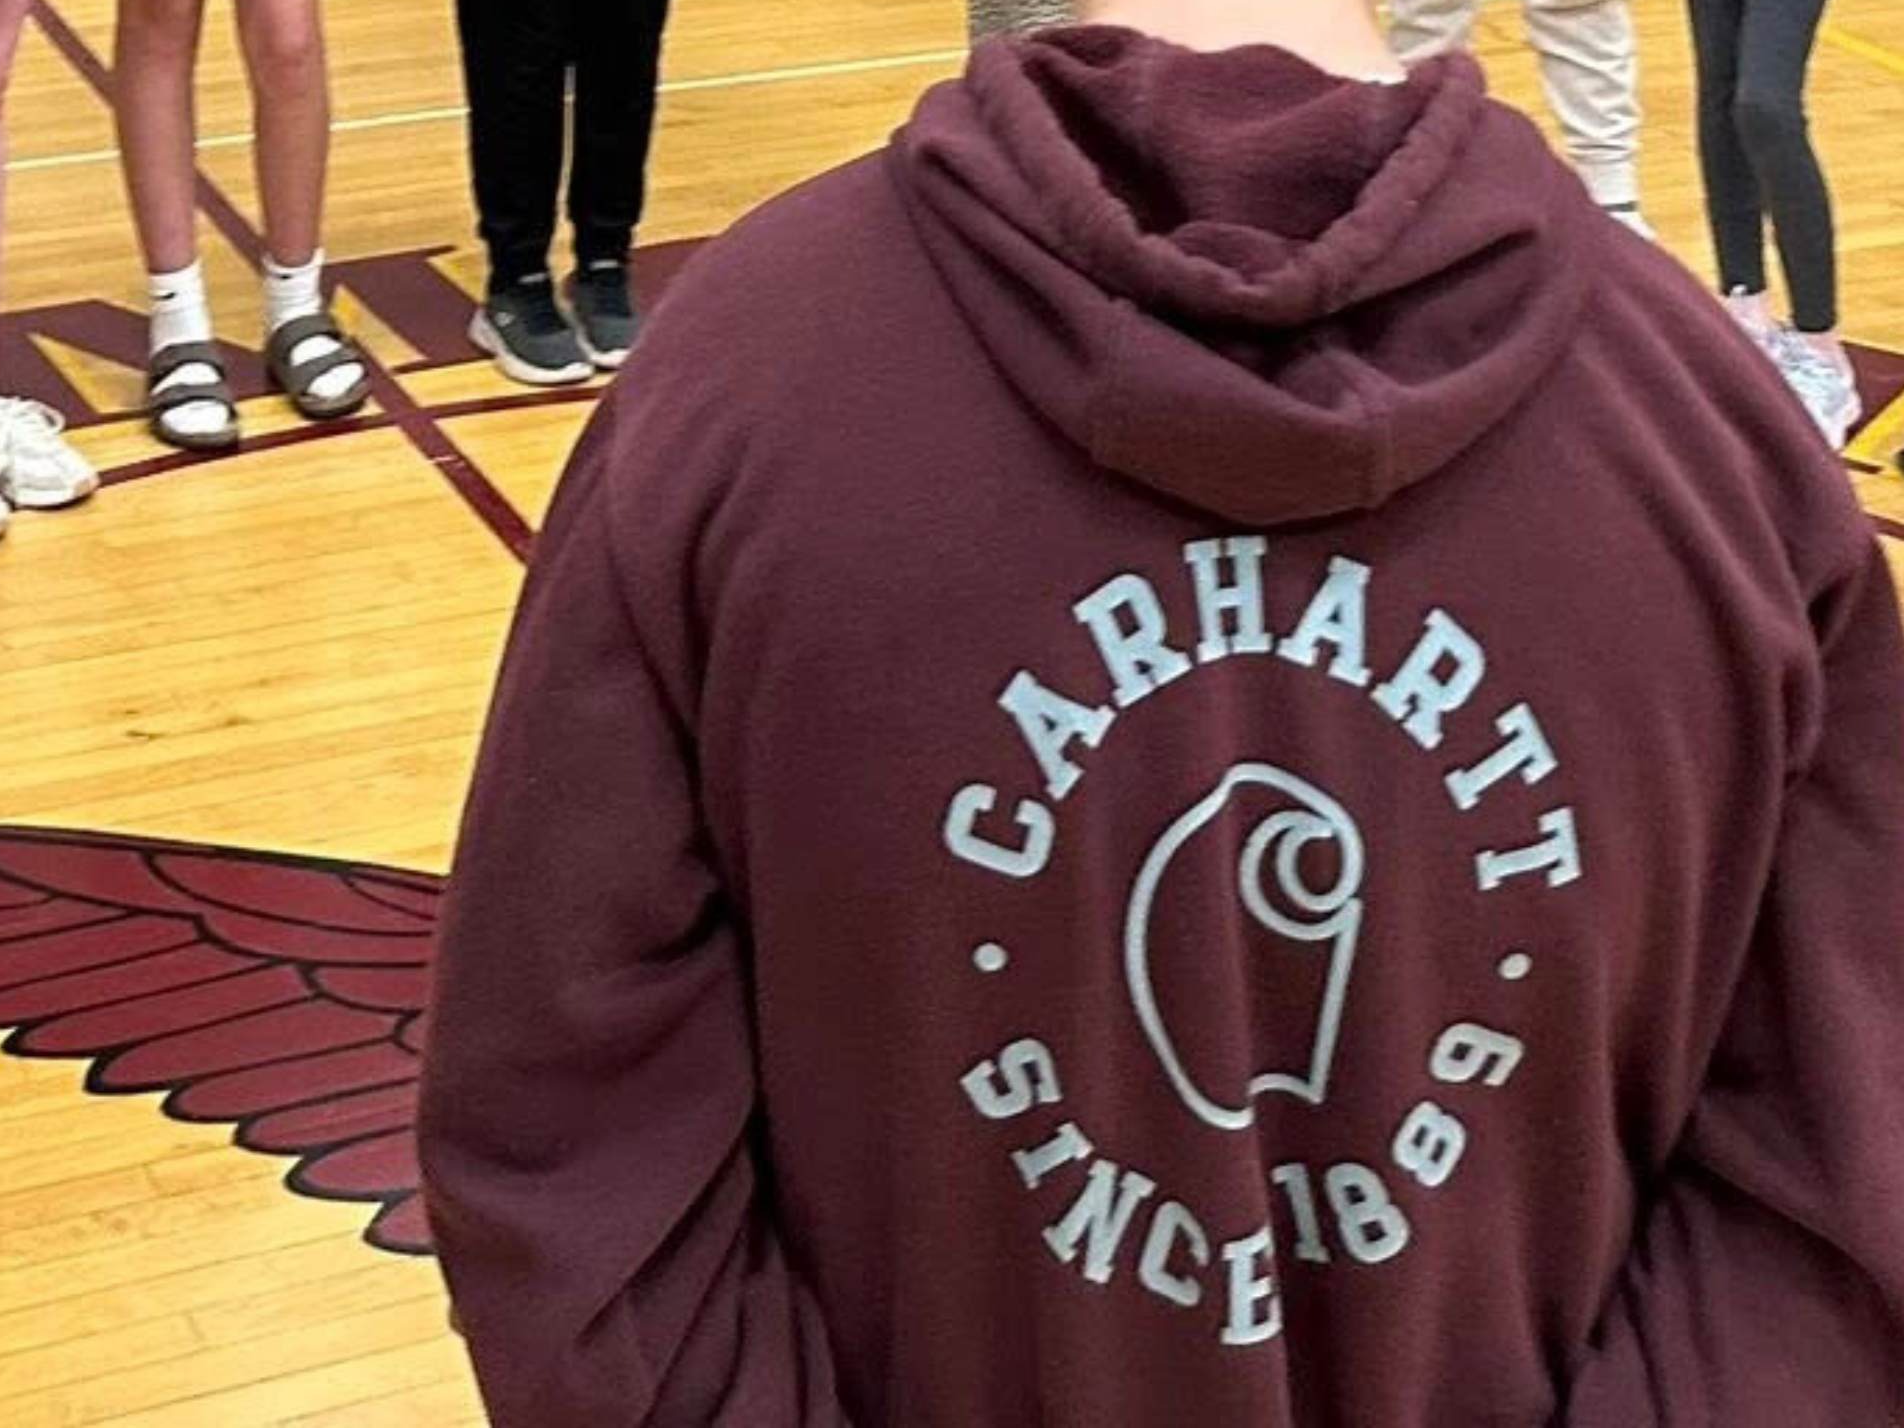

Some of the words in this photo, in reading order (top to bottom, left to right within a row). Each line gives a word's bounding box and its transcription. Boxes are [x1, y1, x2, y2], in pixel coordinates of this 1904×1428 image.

[944, 535, 1582, 891] CARHARTT
[960, 1037, 1284, 1347] SINCE
[1271, 1021, 1525, 1265] 1889
